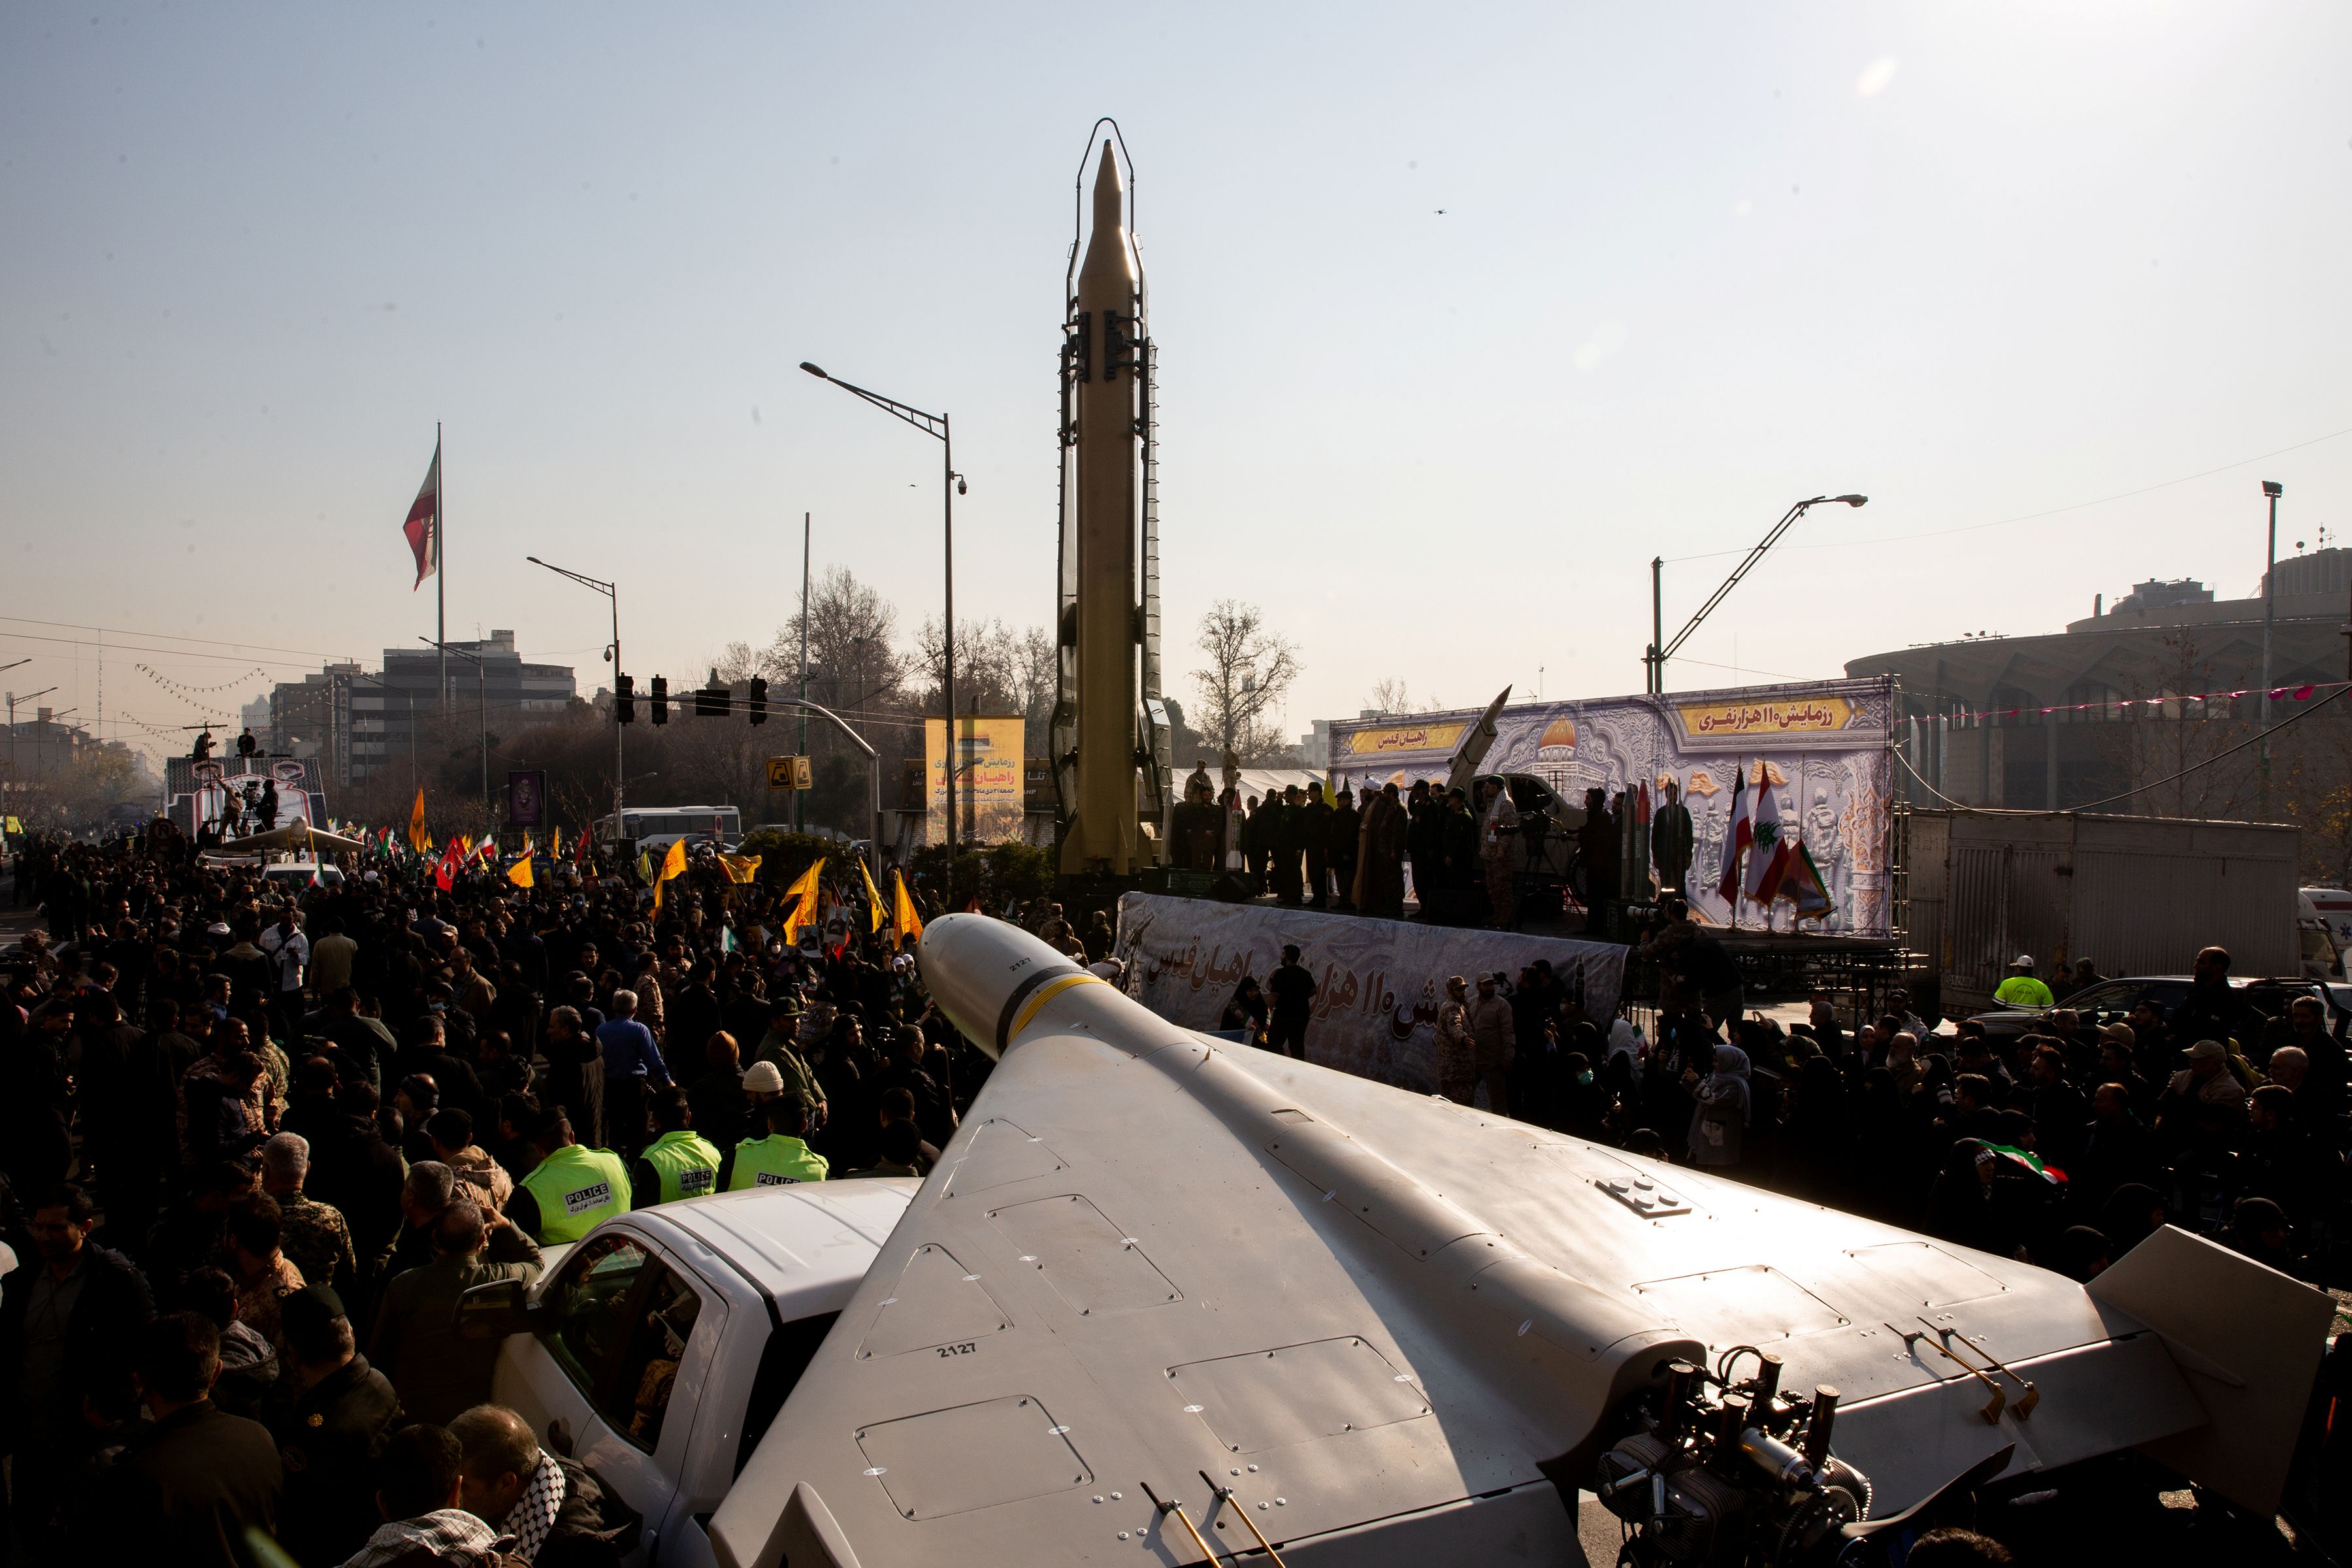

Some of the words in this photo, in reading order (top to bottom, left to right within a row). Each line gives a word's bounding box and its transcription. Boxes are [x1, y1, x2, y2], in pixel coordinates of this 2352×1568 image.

[1699, 708, 1736, 731] نفری
[1734, 708, 1761, 730] هزار
[1763, 706, 1779, 723] ۱۱۰
[1779, 703, 1833, 728] رزمایش
[1378, 729, 1399, 749] قدس
[1399, 729, 1428, 747] راهیان
[984, 758, 1015, 768] رزمایش
[974, 771, 1015, 785] راهیان
[1027, 768, 1047, 781] تئا
[1009, 957, 1031, 972] 2127
[1146, 934, 1201, 985] قدس
[1309, 960, 1359, 1021] هزار
[1362, 968, 1395, 1017] ۱۱۰
[683, 1171, 710, 1183] POLICE
[567, 1184, 608, 1204] POLICE
[937, 1342, 977, 1358] 2127
